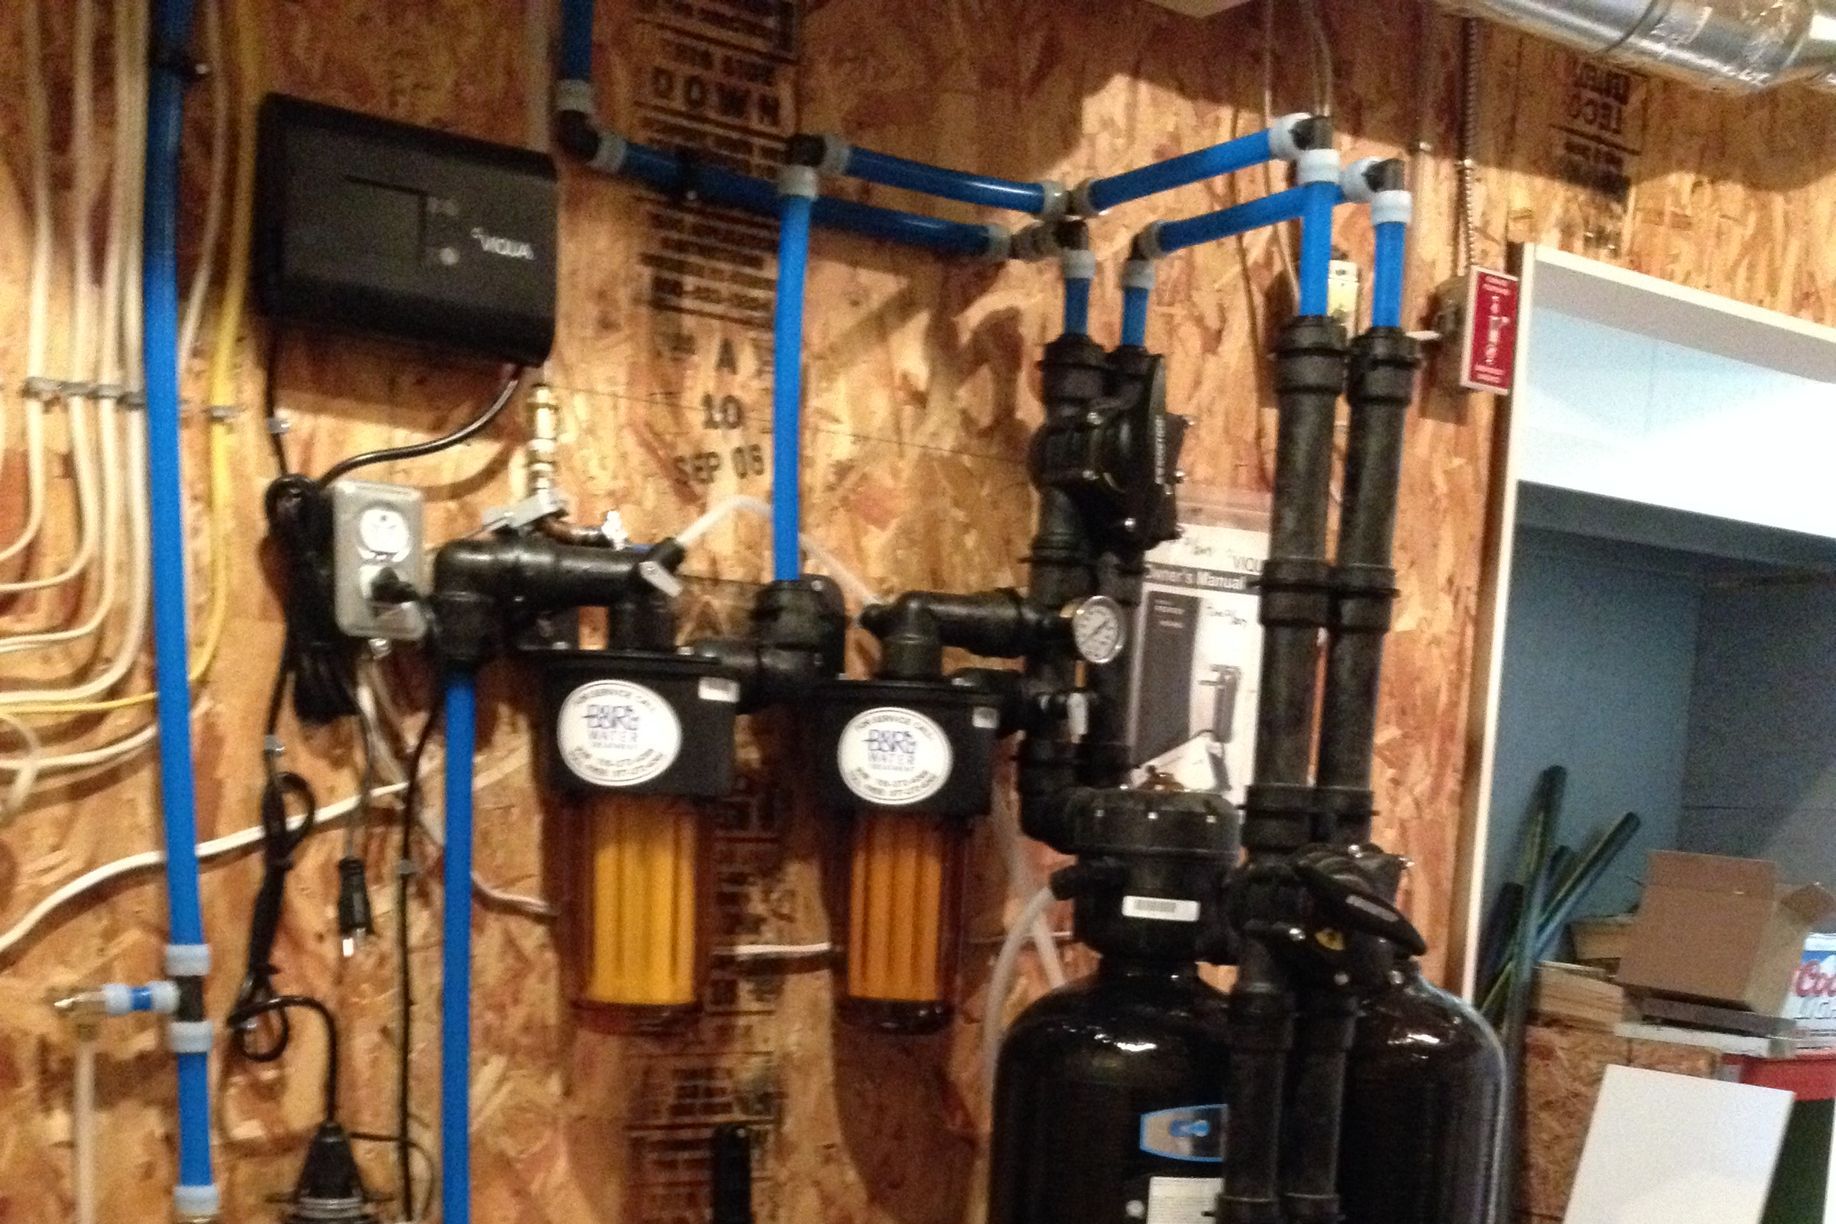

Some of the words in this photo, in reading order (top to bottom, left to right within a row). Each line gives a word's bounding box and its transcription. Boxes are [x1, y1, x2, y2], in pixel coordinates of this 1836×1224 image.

[652, 66, 781, 127] DOWN
[673, 451, 720, 486] SEP
[1197, 570, 1245, 590] Manual
[868, 752, 915, 765] WATER
